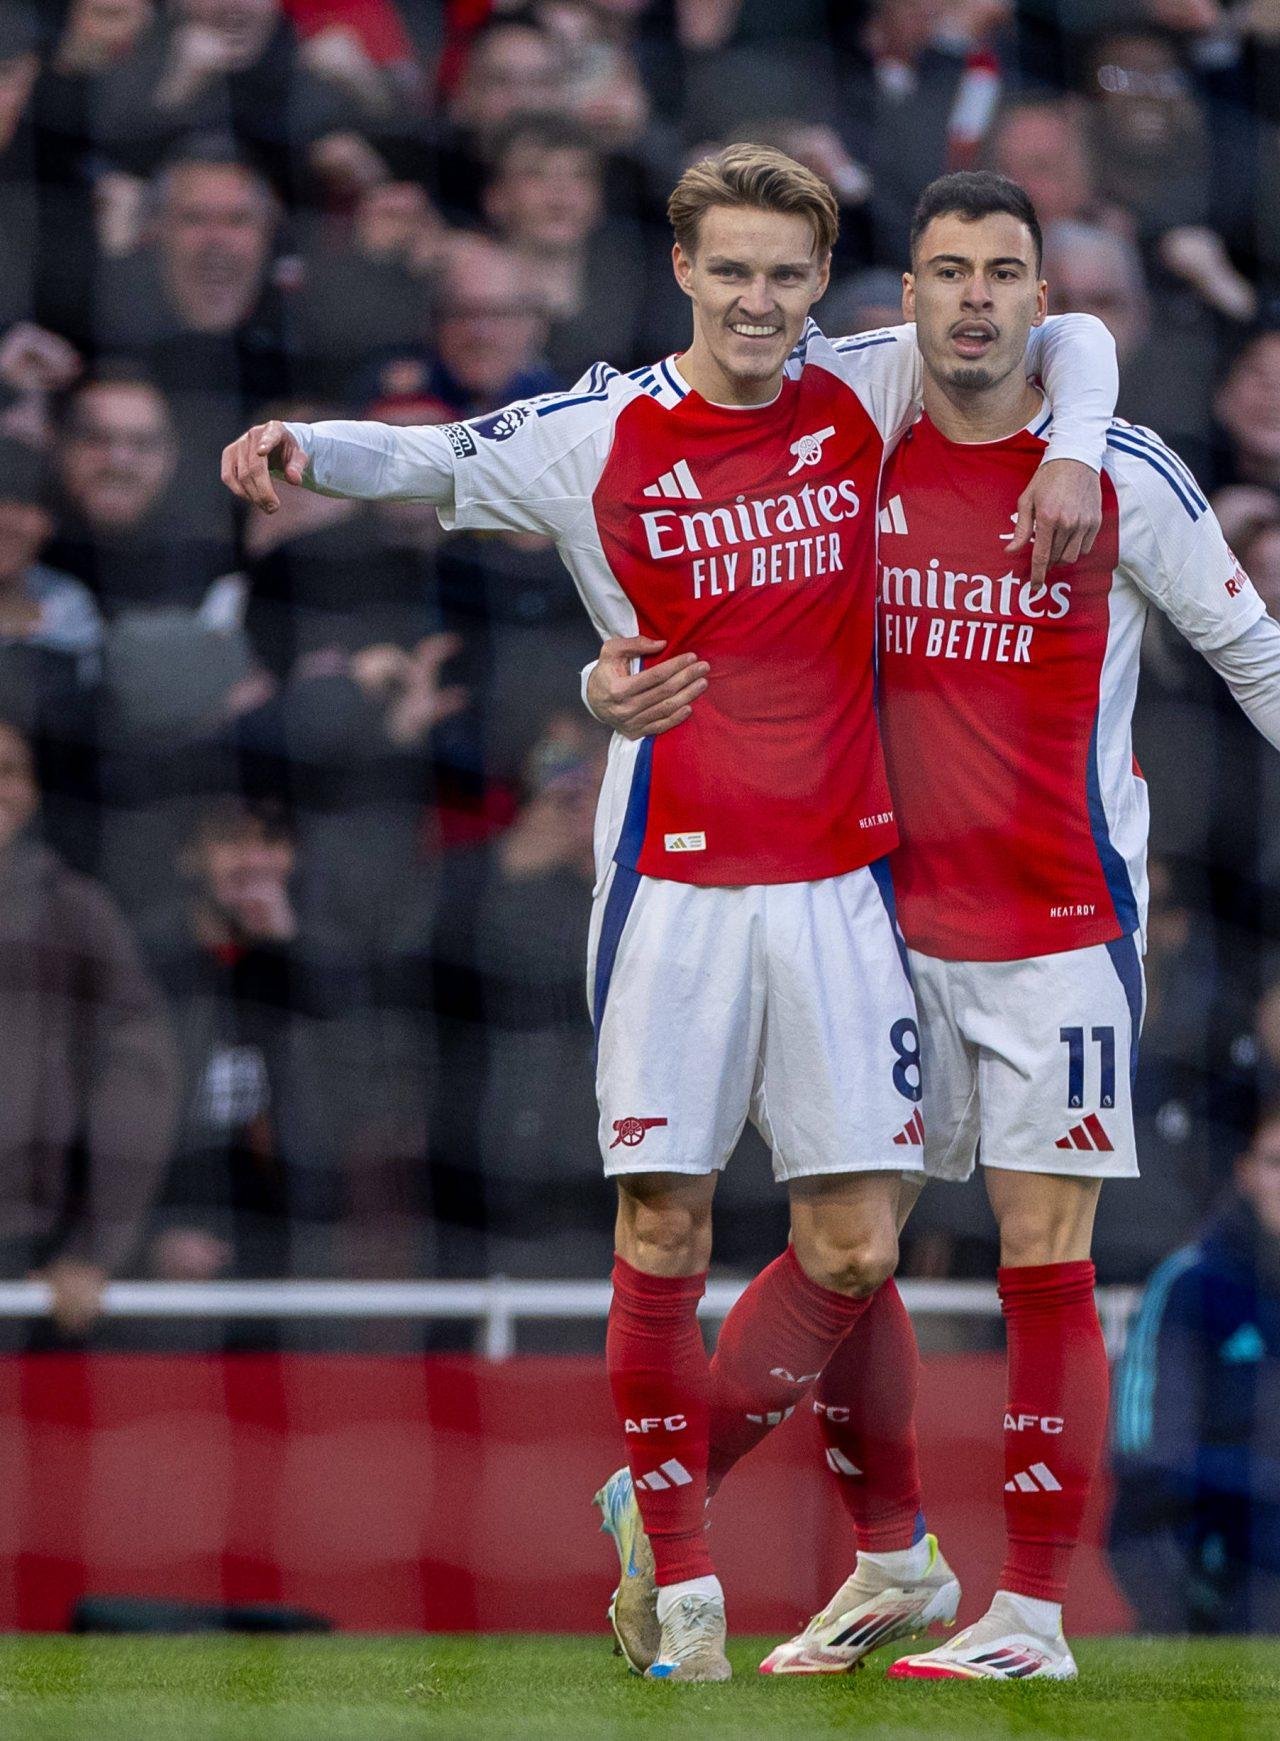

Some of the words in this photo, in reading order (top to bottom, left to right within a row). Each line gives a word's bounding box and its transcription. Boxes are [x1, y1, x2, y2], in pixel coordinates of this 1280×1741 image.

[447, 425, 473, 451] oom
[638, 479, 860, 560] Emirates
[692, 552, 739, 599] FLY
[751, 532, 844, 587] BETTER
[877, 558, 1072, 619] mirates
[885, 614, 919, 655] FLY
[925, 618, 1035, 663] BETTER
[1050, 904, 1096, 918] HEAT.RDY
[889, 1017, 923, 1103] 8
[1059, 1026, 1116, 1109] 11
[624, 1413, 687, 1434] AFC
[812, 1400, 850, 1423] FC
[1003, 1412, 1064, 1434] AFC
